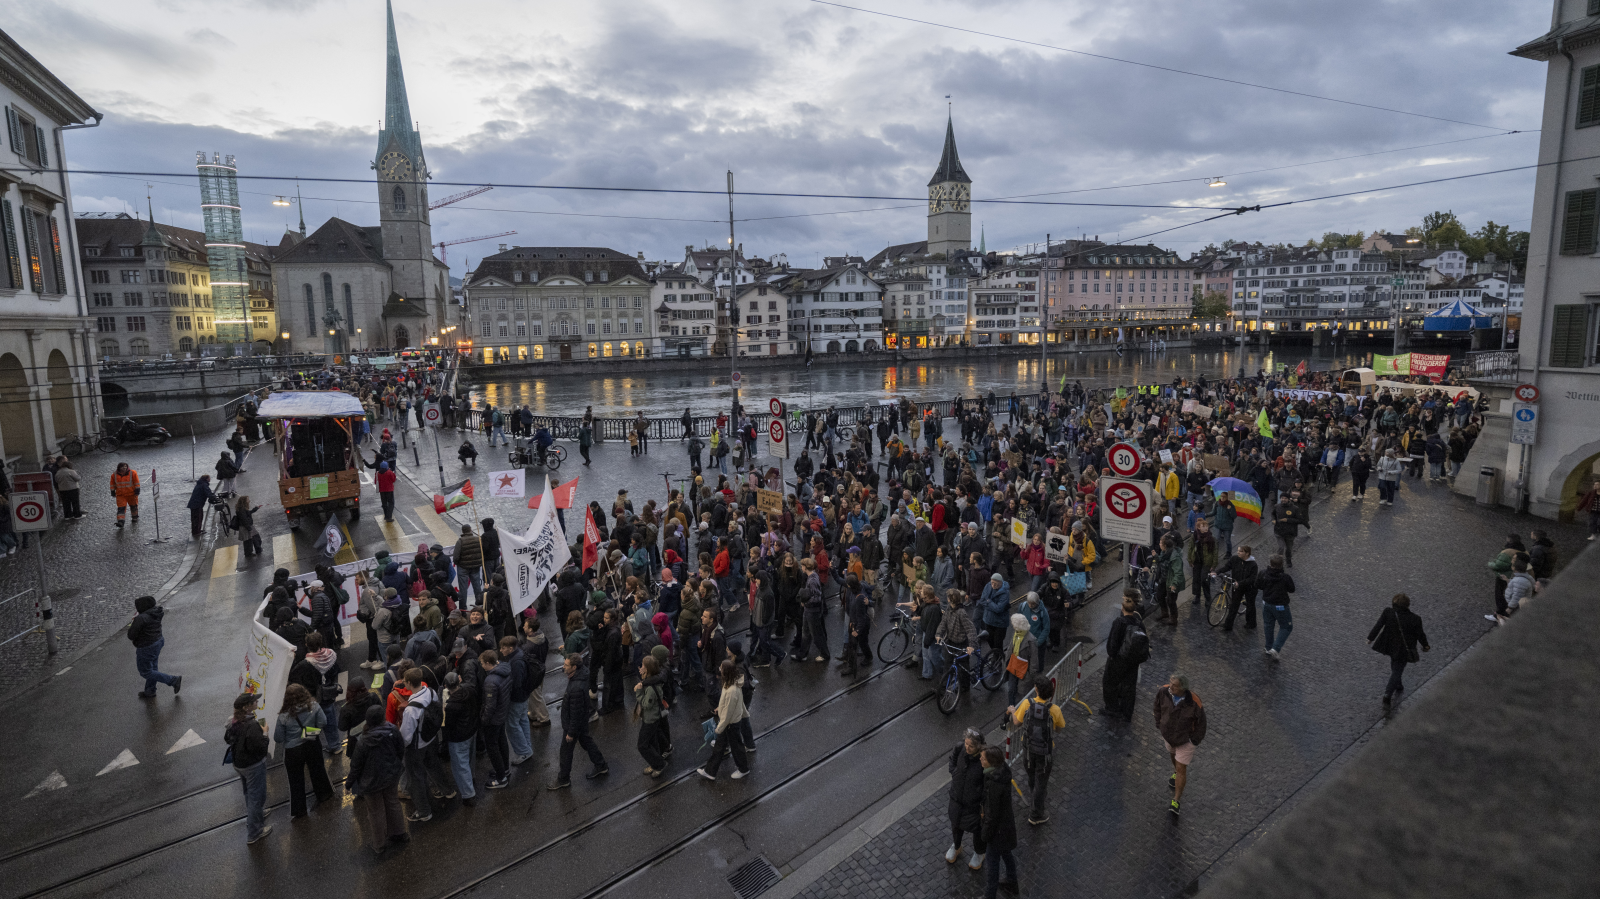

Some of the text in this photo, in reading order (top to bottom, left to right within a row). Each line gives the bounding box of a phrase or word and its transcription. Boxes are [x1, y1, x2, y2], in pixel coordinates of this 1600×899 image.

[1411, 353, 1448, 361] ENTSCHEIDEN
[1411, 359, 1447, 367] PRODUZIEREN
[773, 403, 779, 412] 30
[1118, 454, 1131, 466] 30
[24, 507, 37, 517] 30
